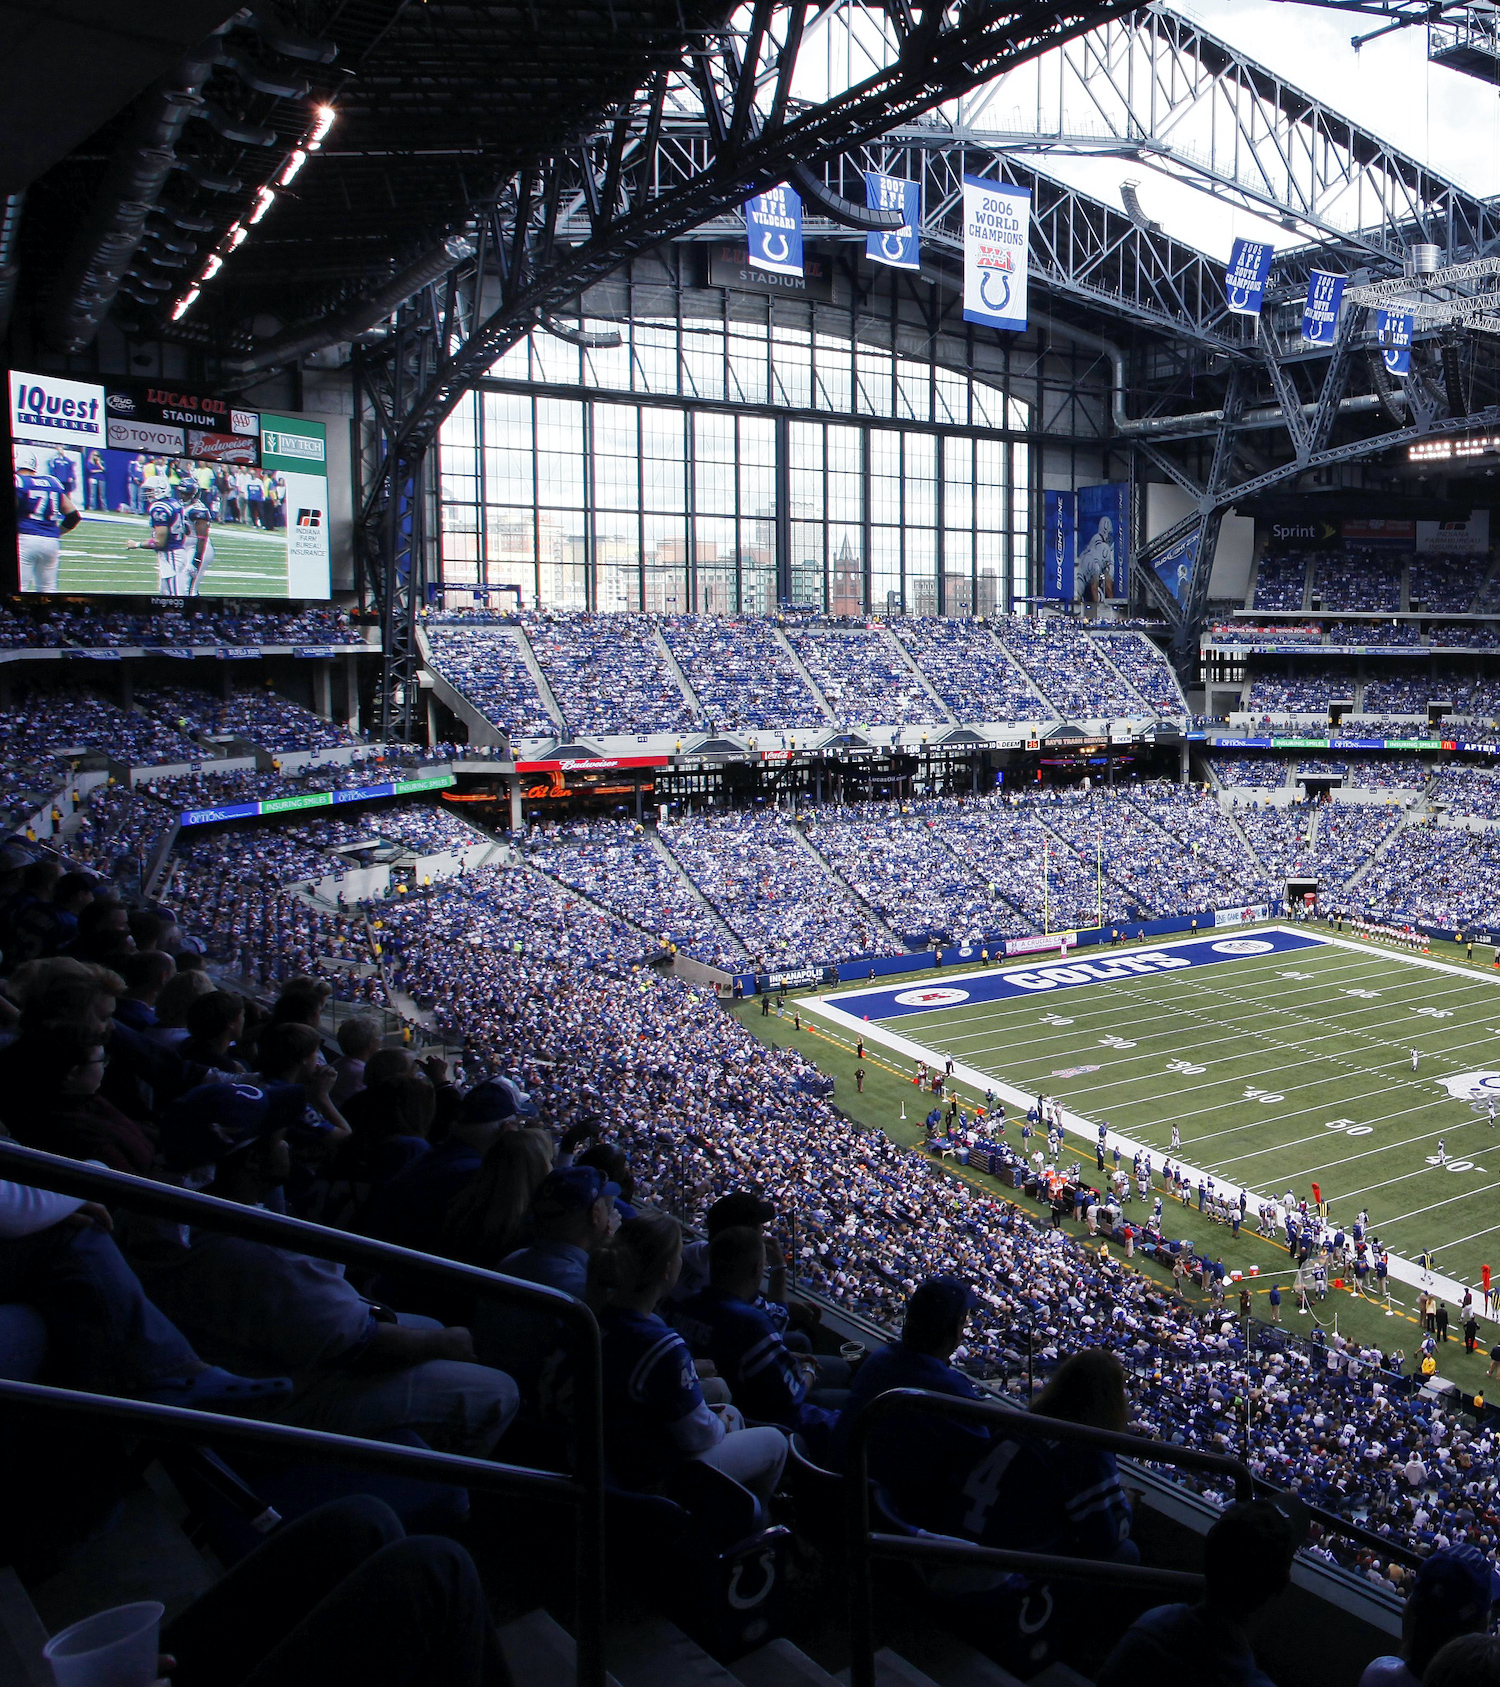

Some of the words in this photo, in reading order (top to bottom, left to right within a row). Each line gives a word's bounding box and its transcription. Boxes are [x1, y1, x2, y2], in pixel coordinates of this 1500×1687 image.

[880, 177, 904, 193] 2007
[761, 199, 786, 216] AFC
[880, 190, 904, 209] AFC
[983, 198, 1013, 216] 2006
[976, 212, 1019, 231] WORLD
[969, 224, 1023, 245] CHAMPIONS
[1242, 243, 1262, 256] 2005
[1237, 253, 1261, 270] AFC
[740, 270, 806, 289] STADIUM
[1234, 267, 1257, 280] SOUTH
[1225, 273, 1262, 292] CHAMPIONS
[1314, 286, 1333, 300] AFC
[18, 384, 99, 420] IQuest
[109, 401, 136, 411] LIGHT
[113, 396, 132, 405] BUD
[147, 389, 197, 410] LUCAS
[202, 399, 227, 414] OIL
[20, 414, 98, 432] INTERNET
[162, 409, 215, 426] STADIUM
[130, 429, 183, 446] TOYOTA
[192, 436, 254, 455] Budweiser
[282, 437, 297, 448] IVY
[298, 440, 321, 451] TECH
[1272, 523, 1315, 540] Sprint
[290, 549, 326, 557] INSURANCE
[151, 597, 184, 608] hhgregg
[822, 749, 834, 757] 14
[903, 745, 920, 753] 1:06
[1464, 743, 1496, 752] AFTER
[559, 759, 618, 770] Budweiser
[400, 782, 427, 792] INSURING
[429, 779, 448, 788] SMILES
[528, 785, 547, 798] Oil
[550, 785, 573, 798] Can
[266, 798, 302, 811] INSURING
[304, 795, 327, 806] SMILES
[338, 791, 367, 803] OPTIONS
[189, 811, 225, 825] OPTIONS
[1003, 952, 1191, 990] COLTS
[1043, 1014, 1074, 1027] 10
[1102, 1034, 1137, 1049] 20
[1170, 1059, 1206, 1075] 30
[1250, 1087, 1285, 1104] 40
[1325, 1118, 1374, 1136] 50
[1426, 1155, 1474, 1173] 40
